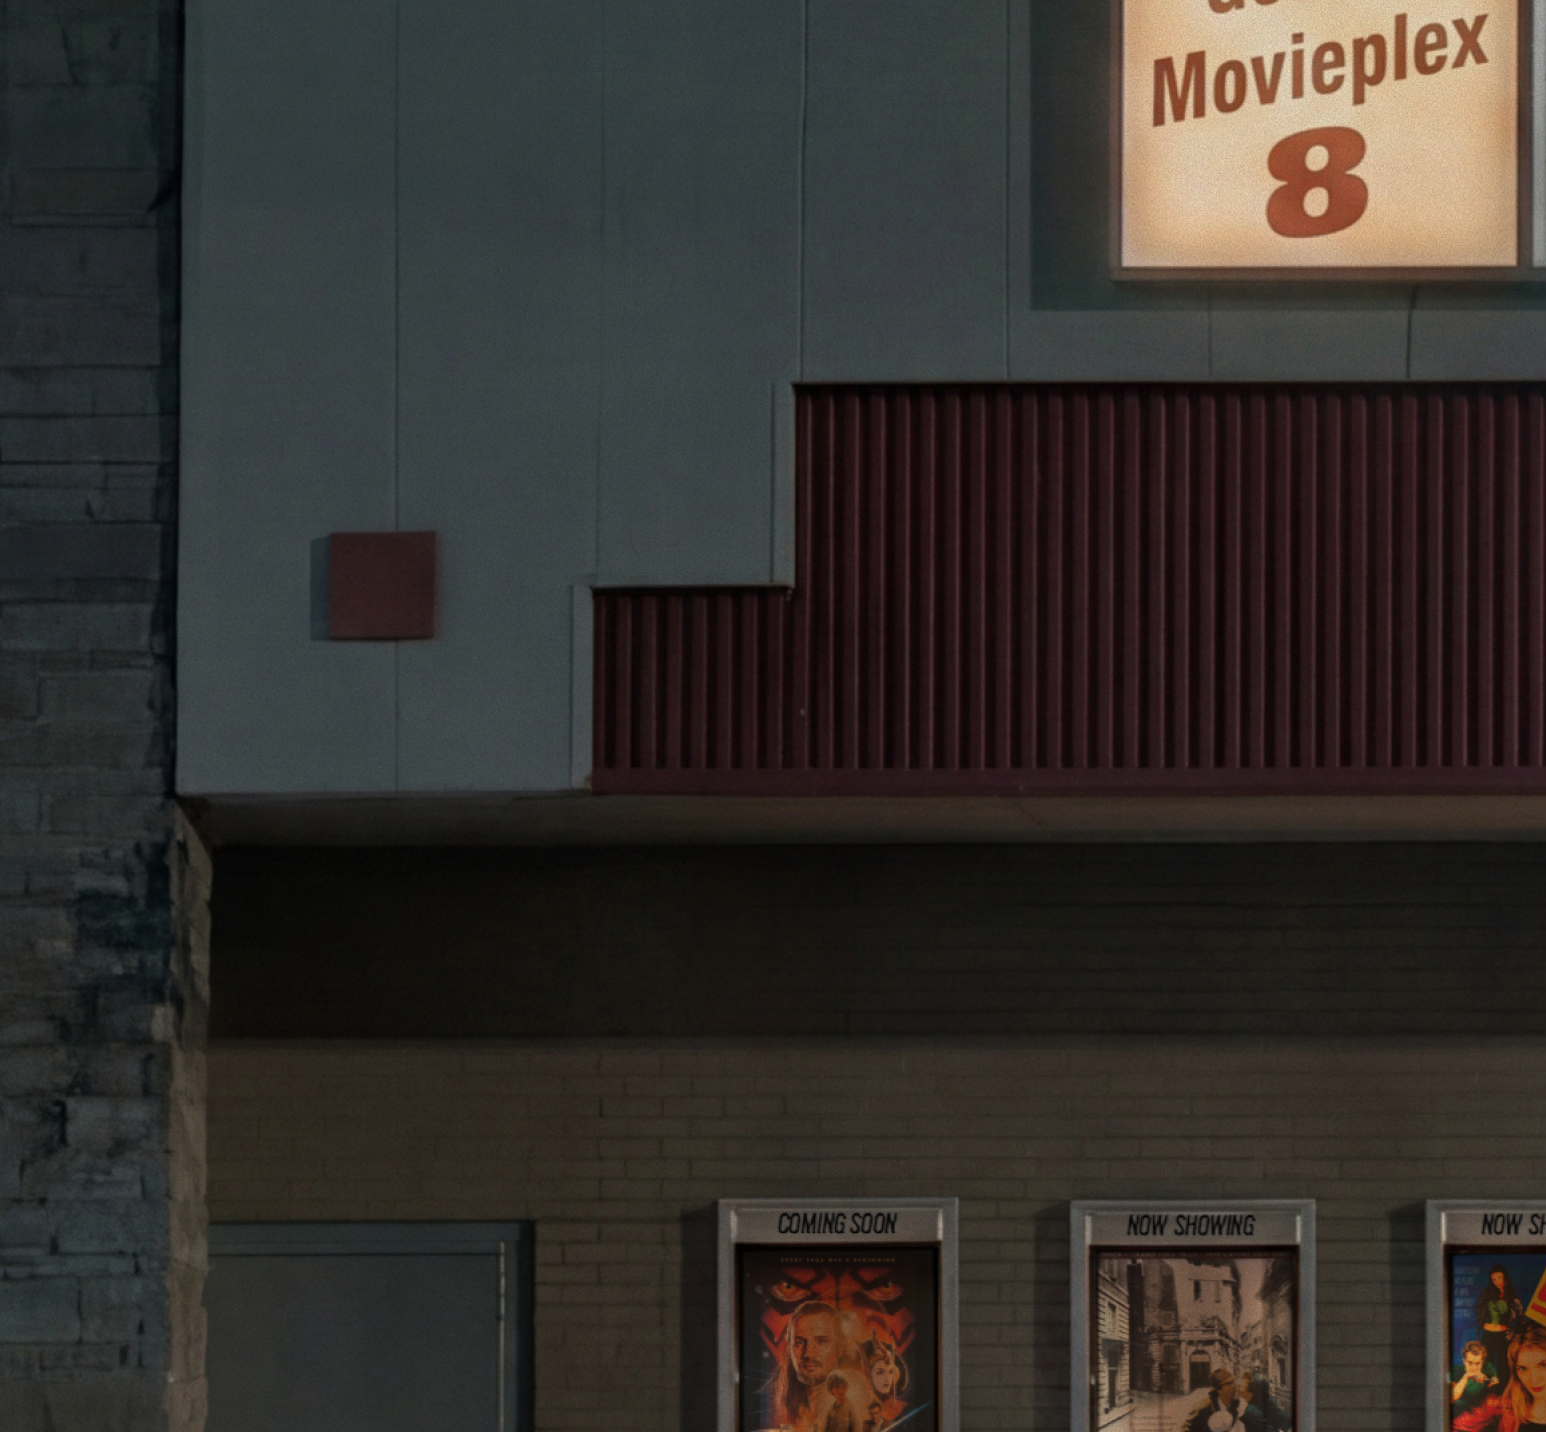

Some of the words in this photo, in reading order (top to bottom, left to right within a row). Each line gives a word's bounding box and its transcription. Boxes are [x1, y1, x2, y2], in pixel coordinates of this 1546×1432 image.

[1152, 13, 1489, 127] Movieplex
[1265, 126, 1369, 238] 8
[778, 1212, 846, 1234] COMING
[850, 1212, 897, 1234] SOON
[1127, 1214, 1168, 1236] NOW
[1174, 1214, 1256, 1236] SHOWING
[1481, 1213, 1523, 1235] NOW
